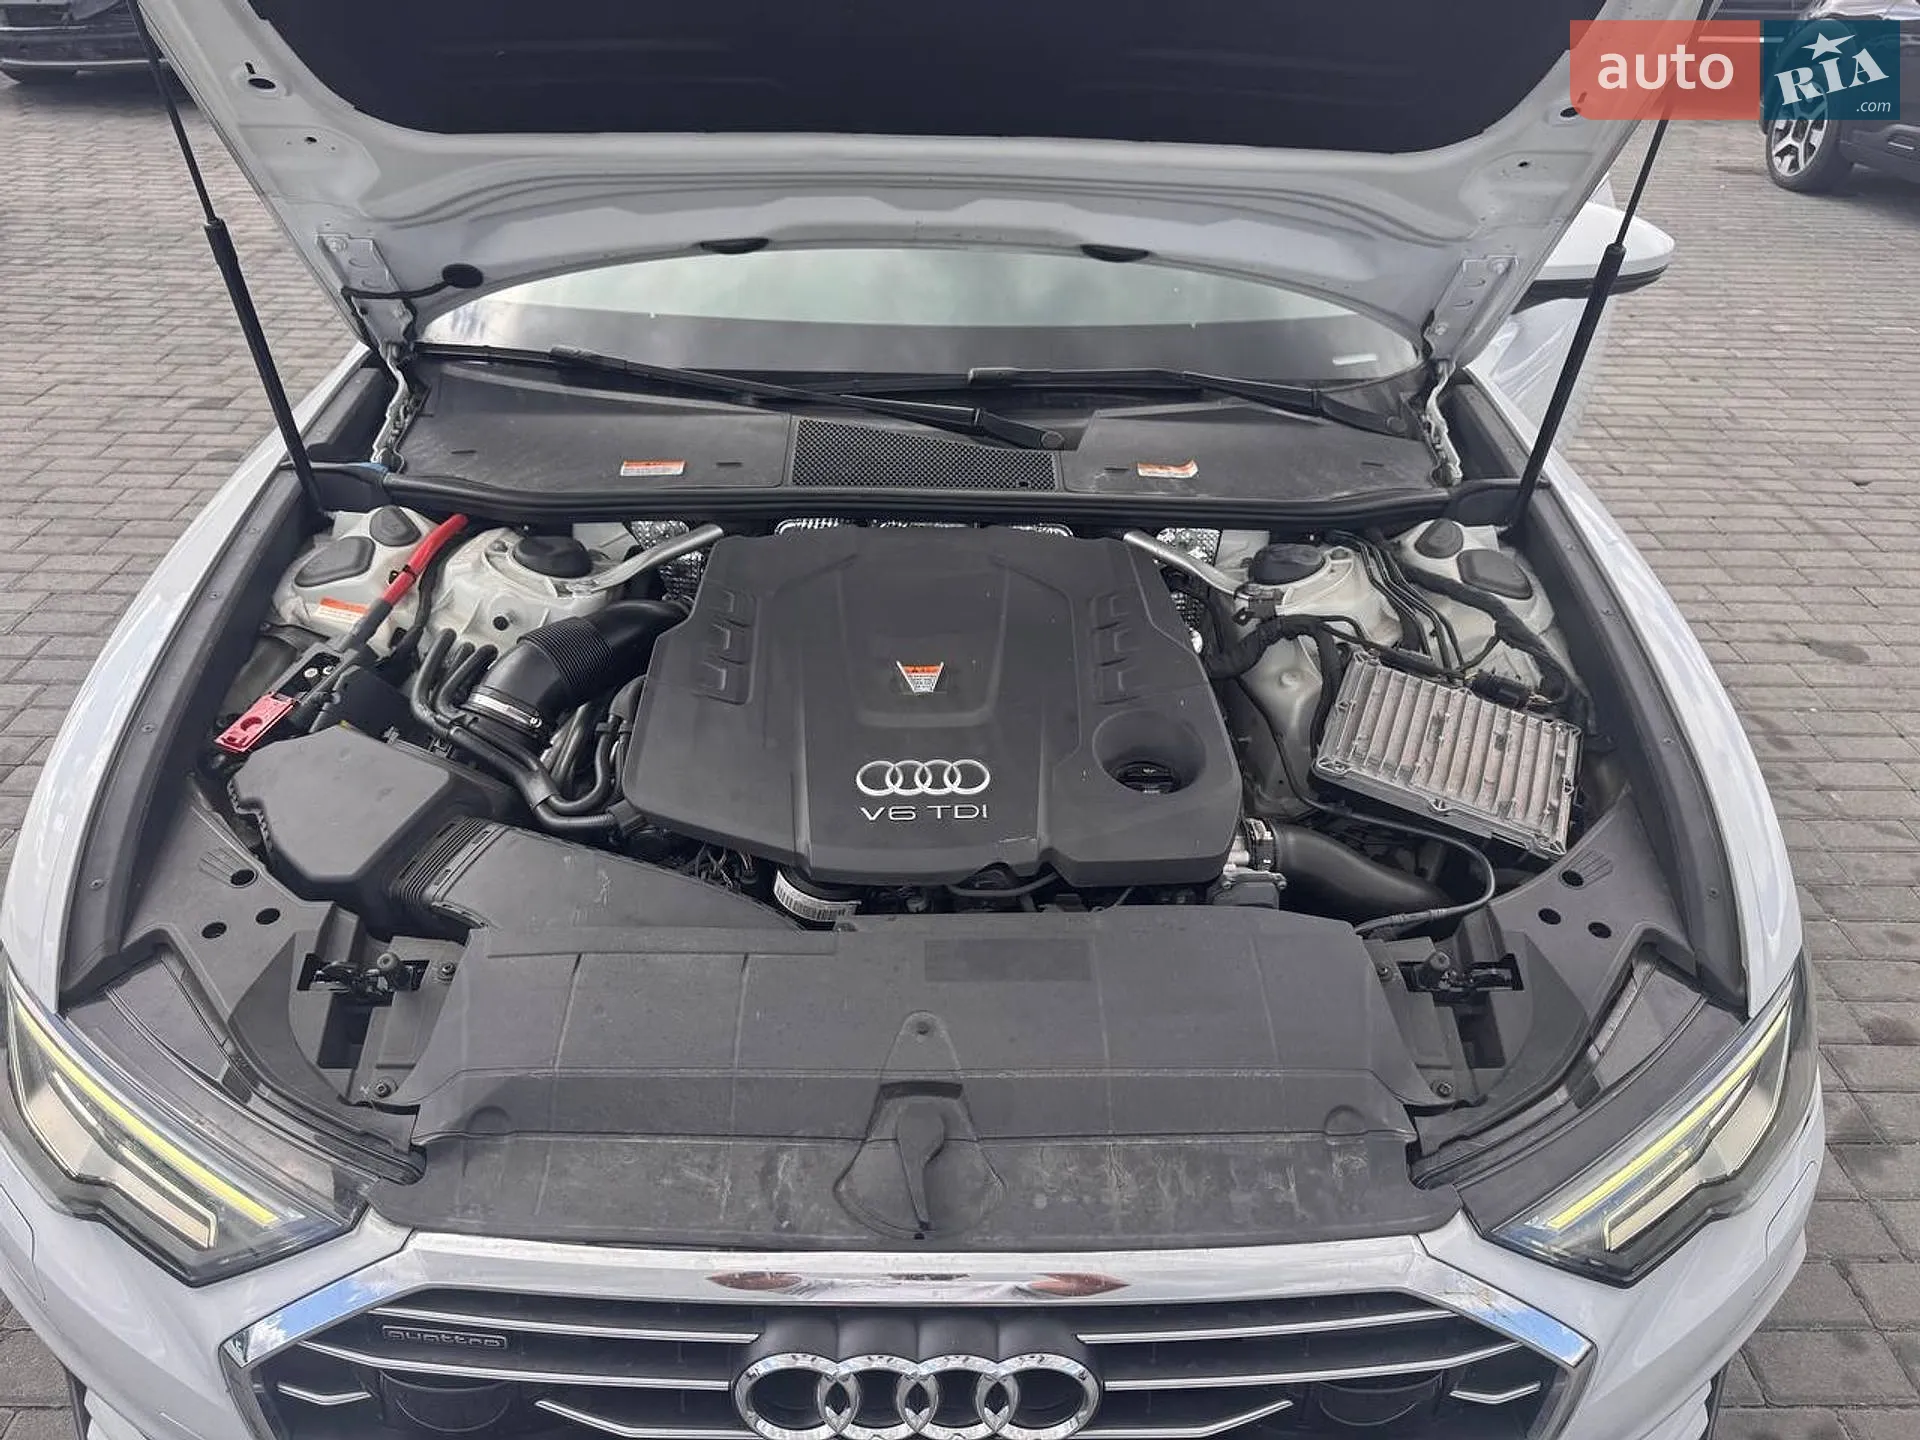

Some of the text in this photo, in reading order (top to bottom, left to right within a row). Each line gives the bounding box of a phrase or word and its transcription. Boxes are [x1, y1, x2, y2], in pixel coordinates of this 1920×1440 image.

[860, 804, 988, 821] V6 TDI
[387, 1329, 501, 1348] quattro
